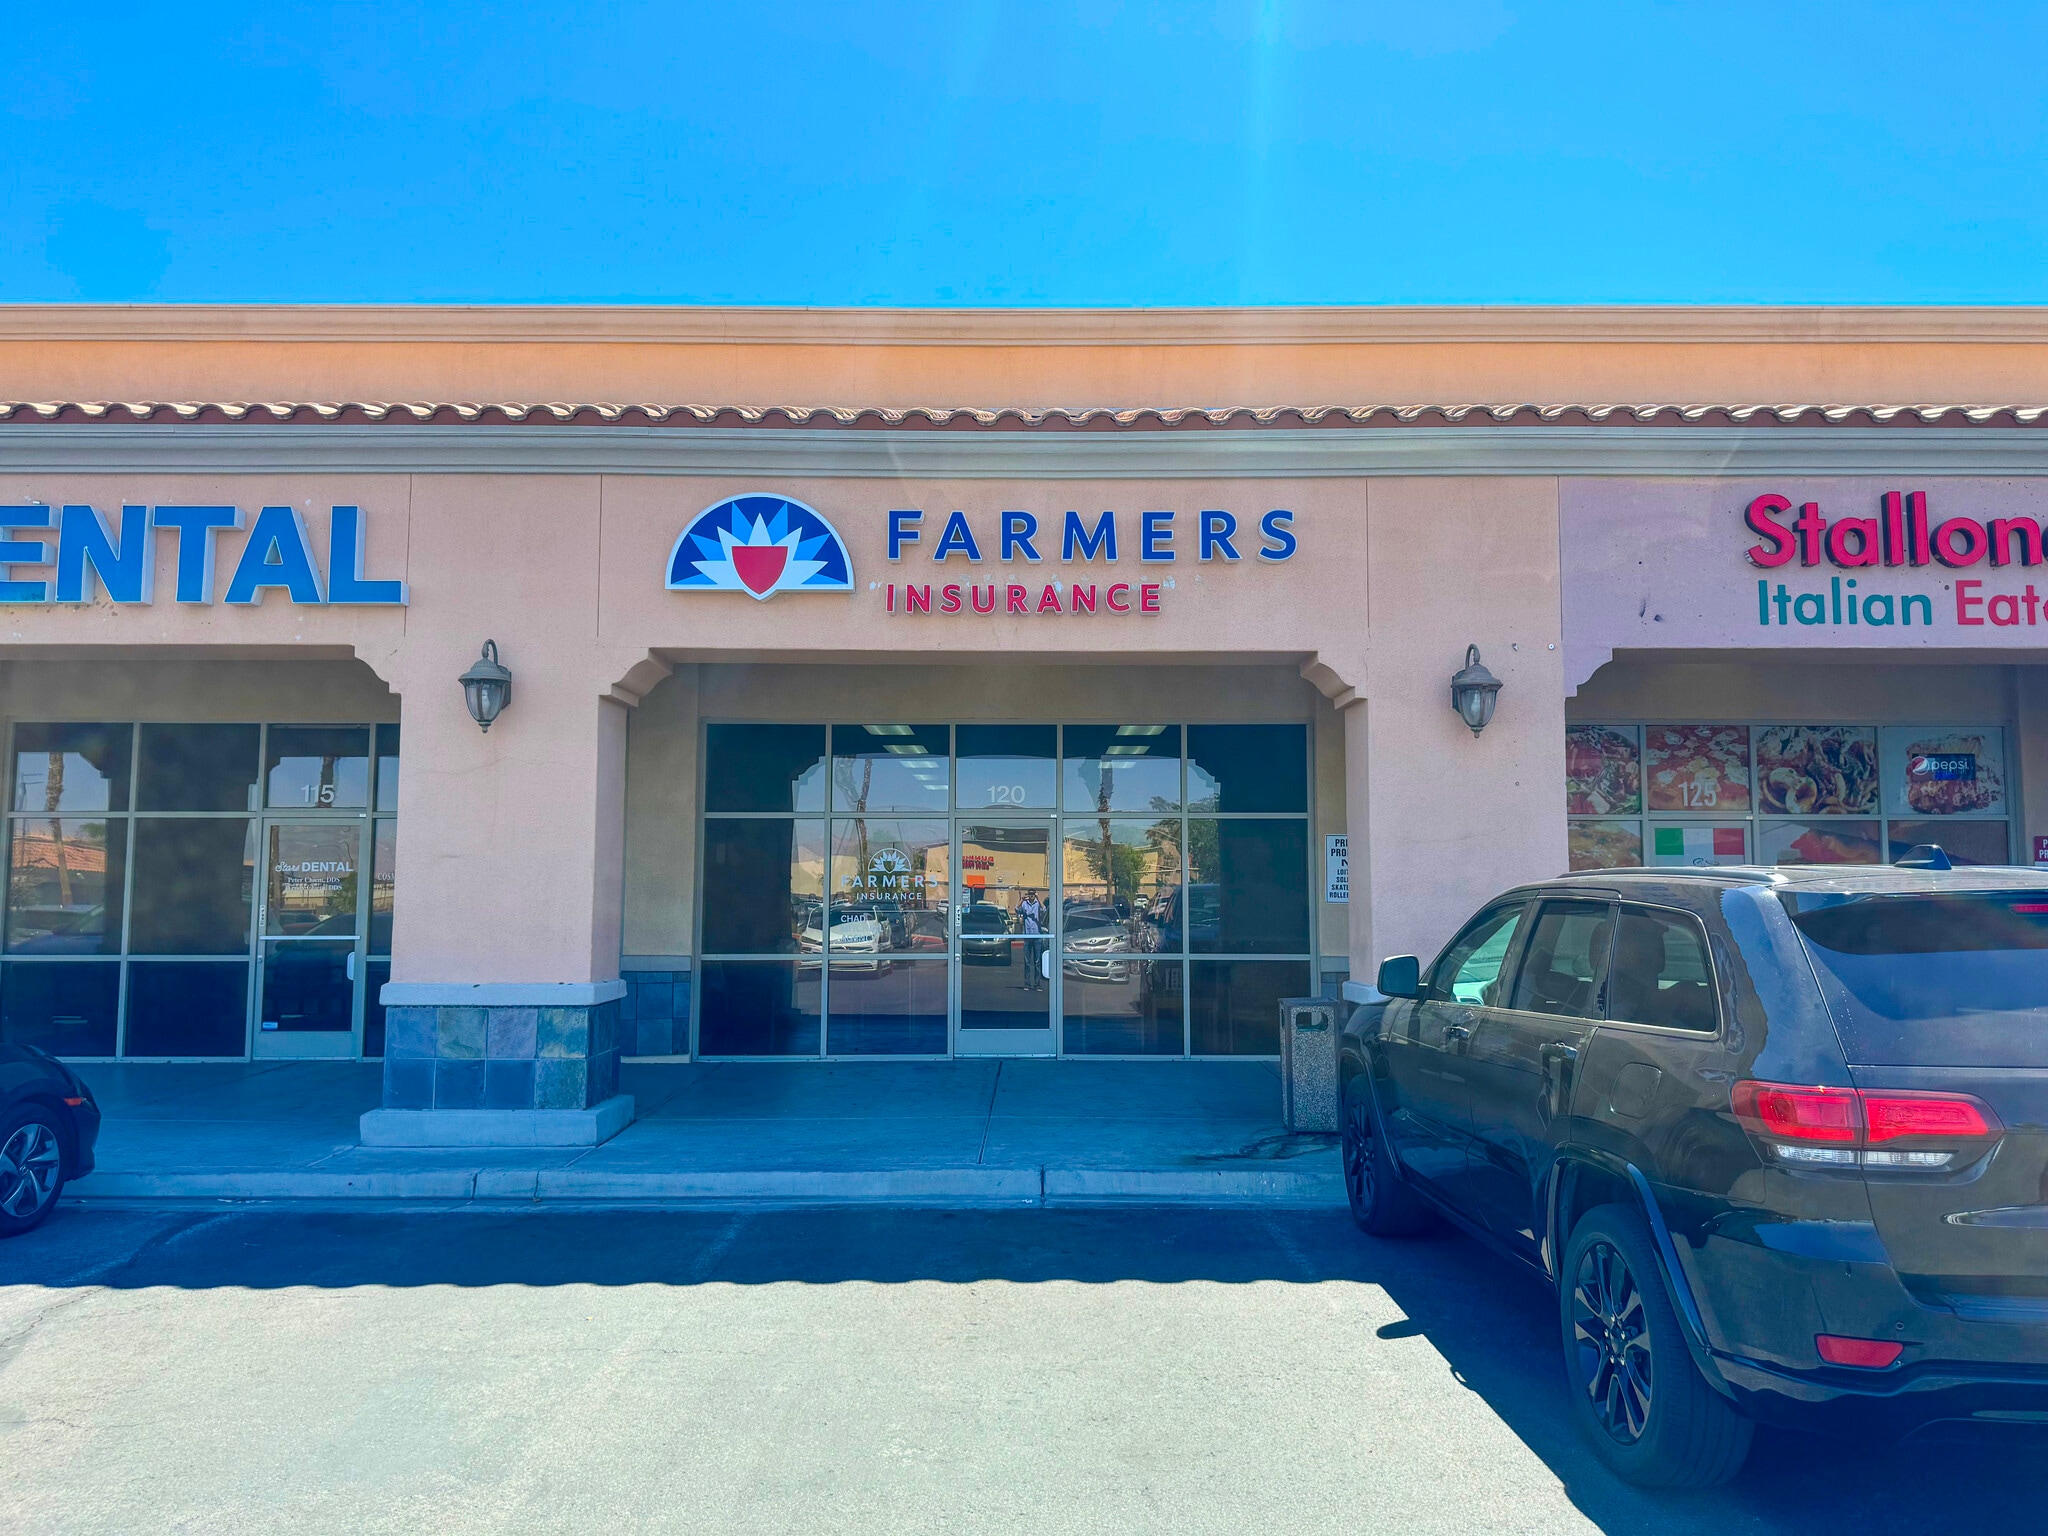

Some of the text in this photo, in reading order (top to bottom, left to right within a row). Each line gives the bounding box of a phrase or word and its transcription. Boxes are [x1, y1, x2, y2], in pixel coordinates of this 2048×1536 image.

[886, 508, 1298, 565] FARMERS
[1743, 490, 2048, 568] Stallon
[886, 582, 1162, 616] INSURANCE
[1758, 576, 2048, 626] Italian Eat
[1931, 758, 1969, 773] pepsi
[301, 784, 335, 803] 115
[987, 785, 1026, 803] 120
[1678, 781, 1717, 807] 125
[1331, 849, 1348, 857] PRO
[301, 861, 354, 872] DENTAL
[840, 875, 939, 888] FARMERS
[856, 892, 922, 900] INSURANCE
[840, 914, 866, 923] CHAD
